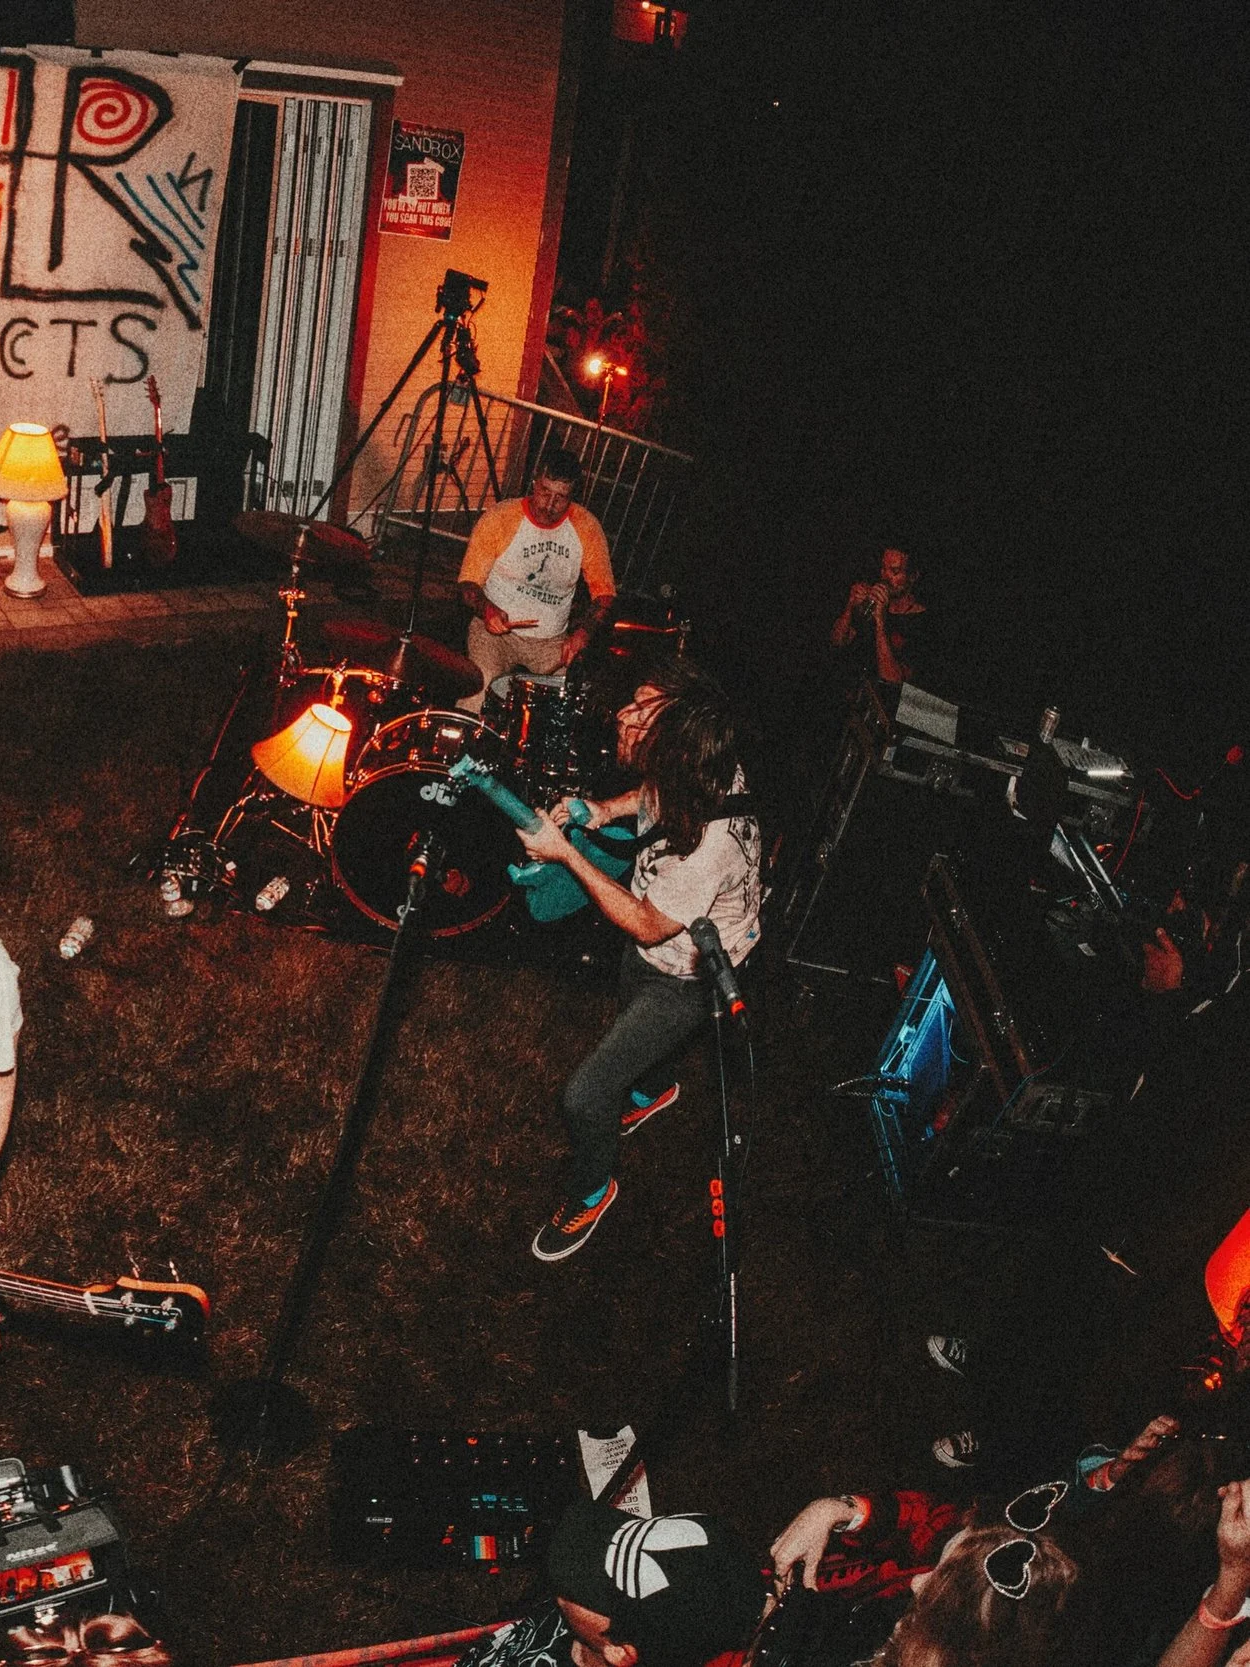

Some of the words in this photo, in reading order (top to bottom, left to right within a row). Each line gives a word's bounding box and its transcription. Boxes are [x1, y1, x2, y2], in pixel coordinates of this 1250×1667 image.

[394, 133, 461, 160] SANDBOX
[400, 212, 418, 224] SCAN
[419, 214, 434, 226] THIS
[523, 541, 570, 559] RUNNING
